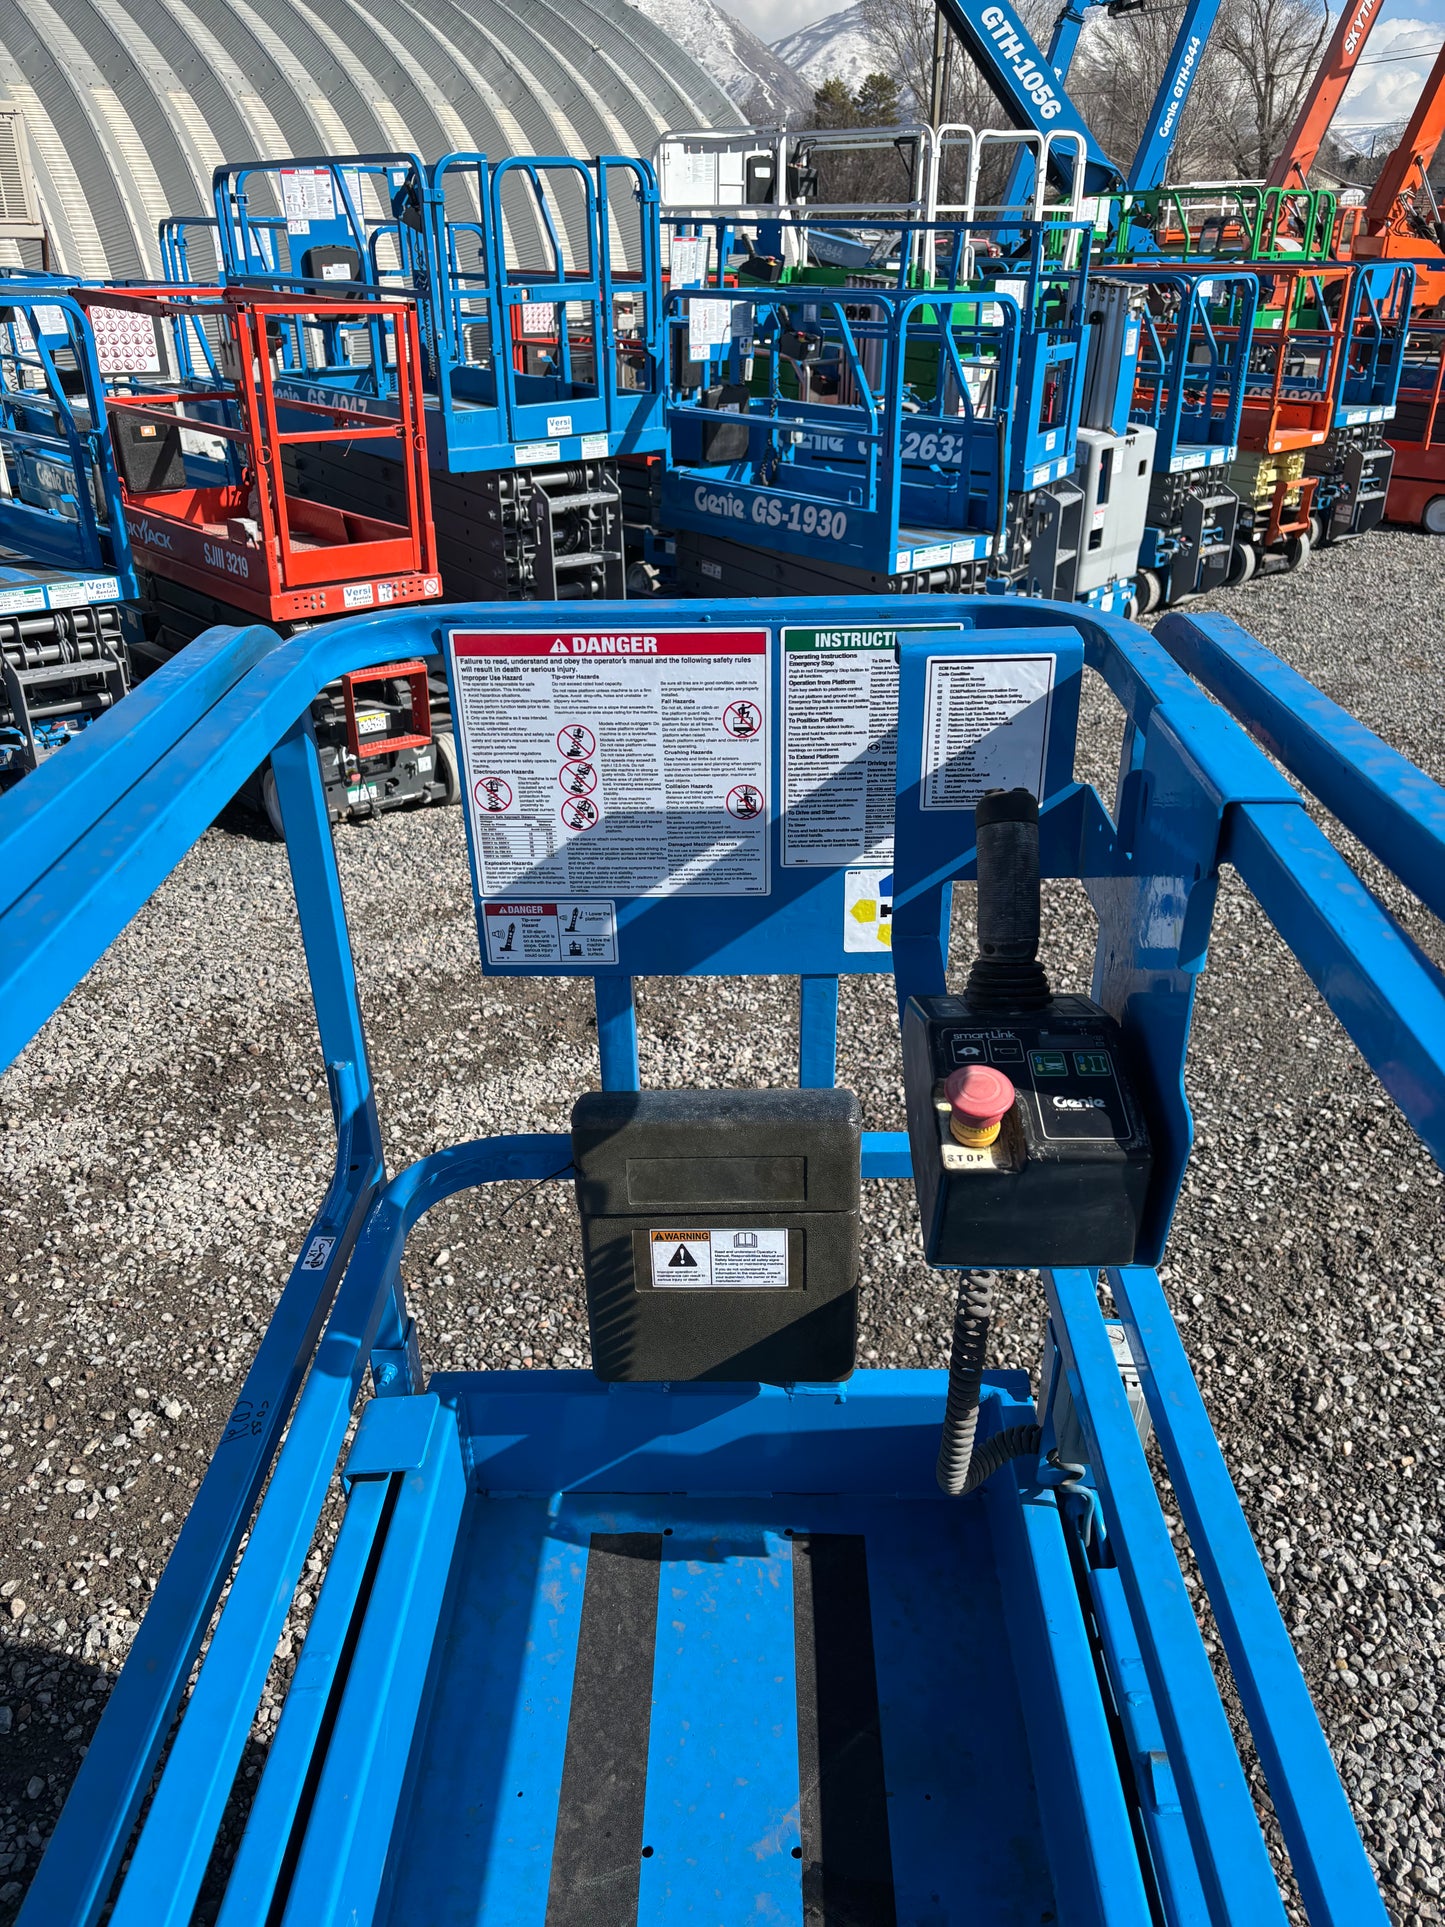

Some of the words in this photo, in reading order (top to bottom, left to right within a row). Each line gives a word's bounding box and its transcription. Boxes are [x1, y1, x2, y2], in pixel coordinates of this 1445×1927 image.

[981, 6, 1062, 119] GTH-1056
[1159, 101, 1180, 138] Genie
[1173, 36, 1200, 98] GTH-844
[548, 417, 570, 426] Versi
[694, 486, 744, 519] Genie
[752, 496, 848, 540] GS-1930
[226, 552, 249, 579] 3219
[87, 579, 116, 590] Versi
[345, 586, 372, 598] Versi
[572, 636, 658, 653] DANGER
[815, 632, 896, 648] INSTRUCTI
[594, 657, 626, 665] operator's
[508, 906, 543, 914] DANGER
[1053, 1096, 1106, 1108] Genie
